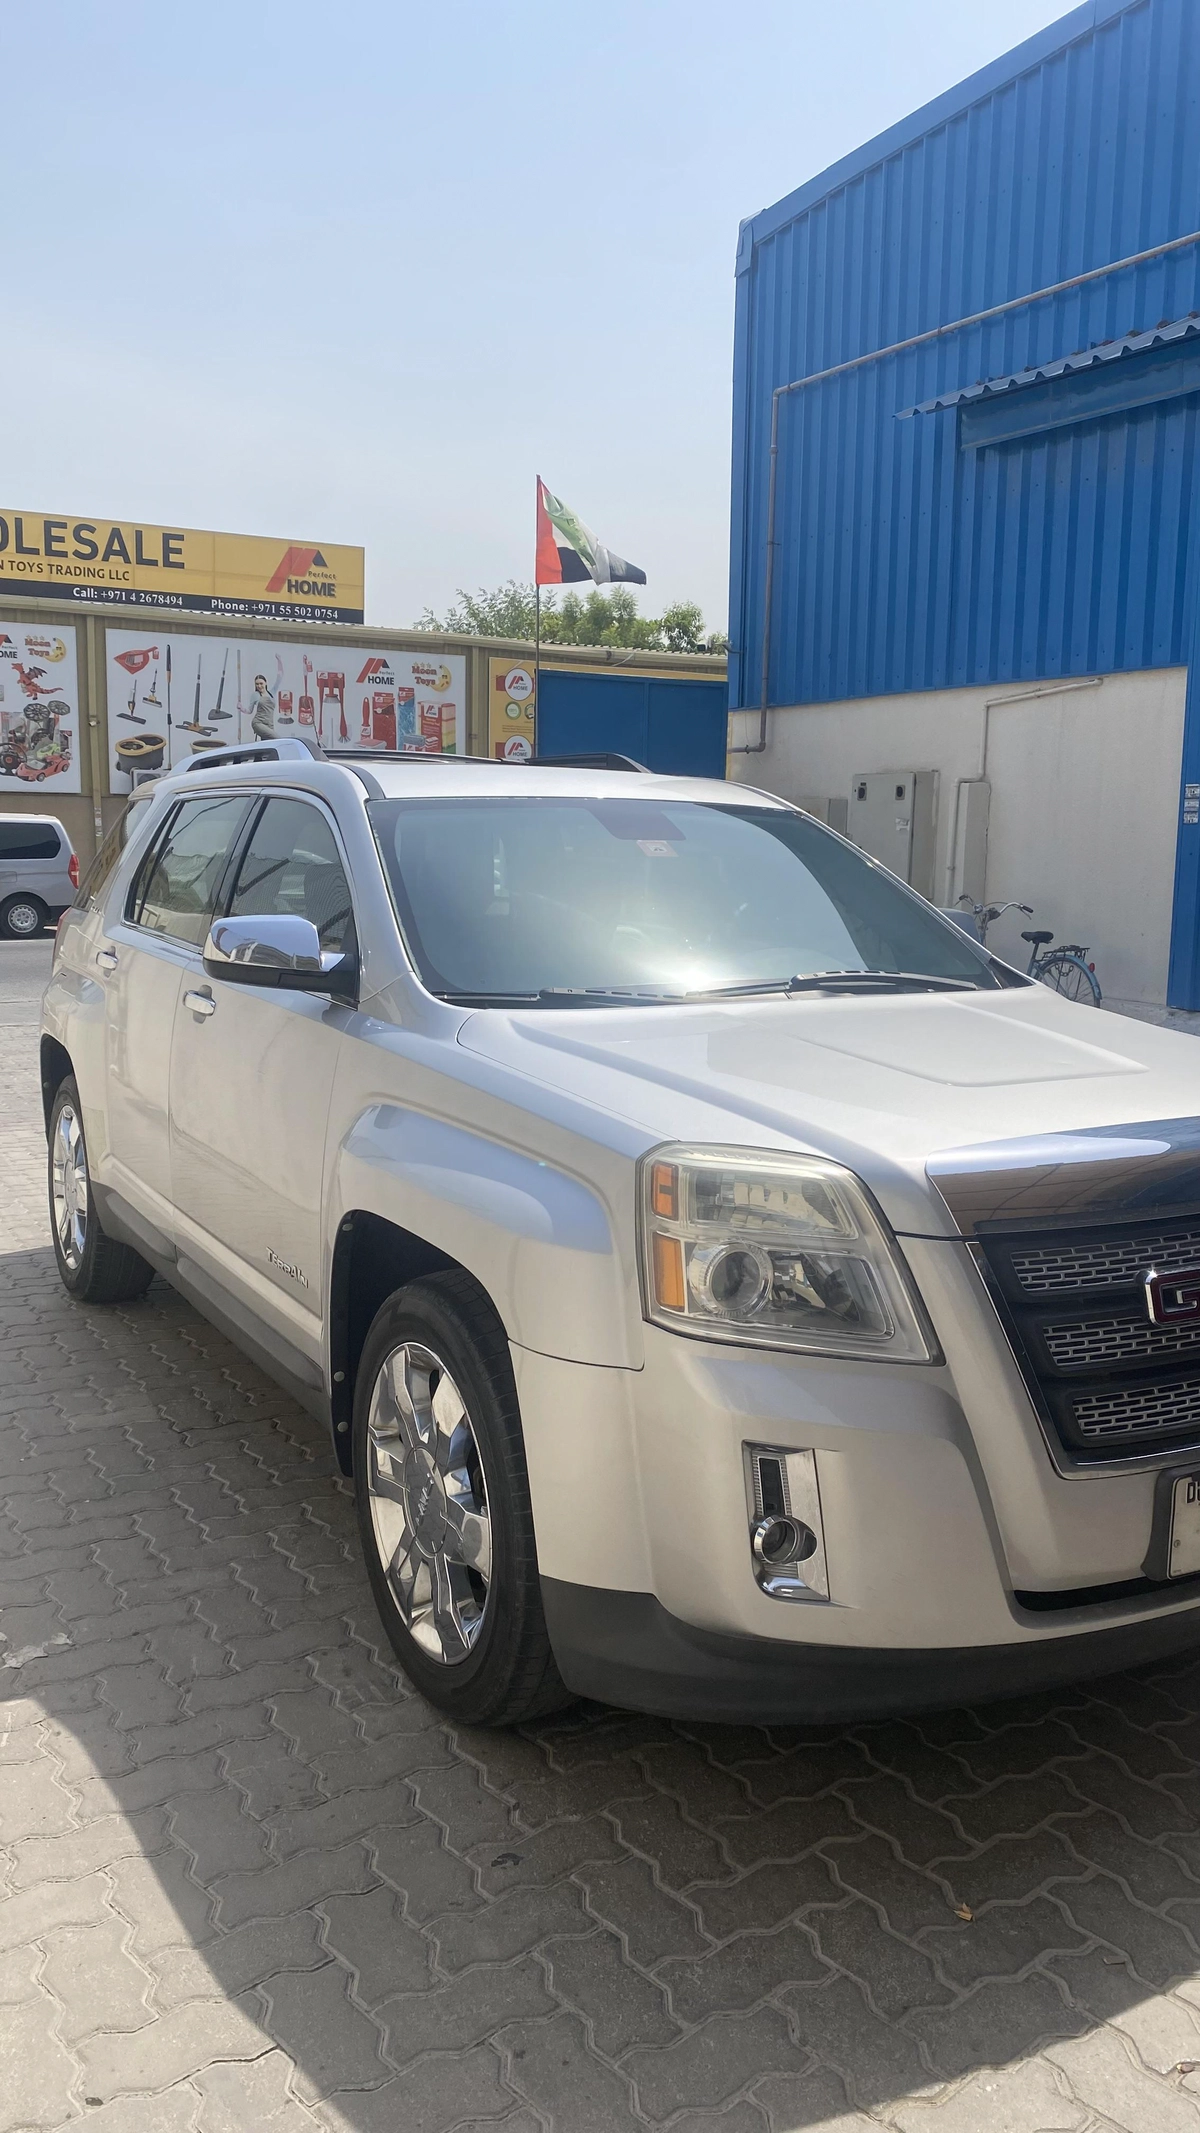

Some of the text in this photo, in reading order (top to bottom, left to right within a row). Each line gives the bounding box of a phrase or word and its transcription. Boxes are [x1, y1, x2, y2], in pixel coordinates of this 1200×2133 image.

[0, 516, 185, 570] LESALE
[8, 560, 44, 574] TOYS
[47, 563, 105, 579] TRADING
[108, 569, 130, 581] LLC
[308, 570, 337, 581] Perfect
[73, 587, 183, 606] Call: +971 4 2678494
[287, 578, 336, 598] HOME
[211, 599, 339, 620] Phone: +971 55 502 0754
[412, 665, 438, 676] Moon
[367, 676, 395, 685] HOME
[415, 676, 436, 687] Toys
